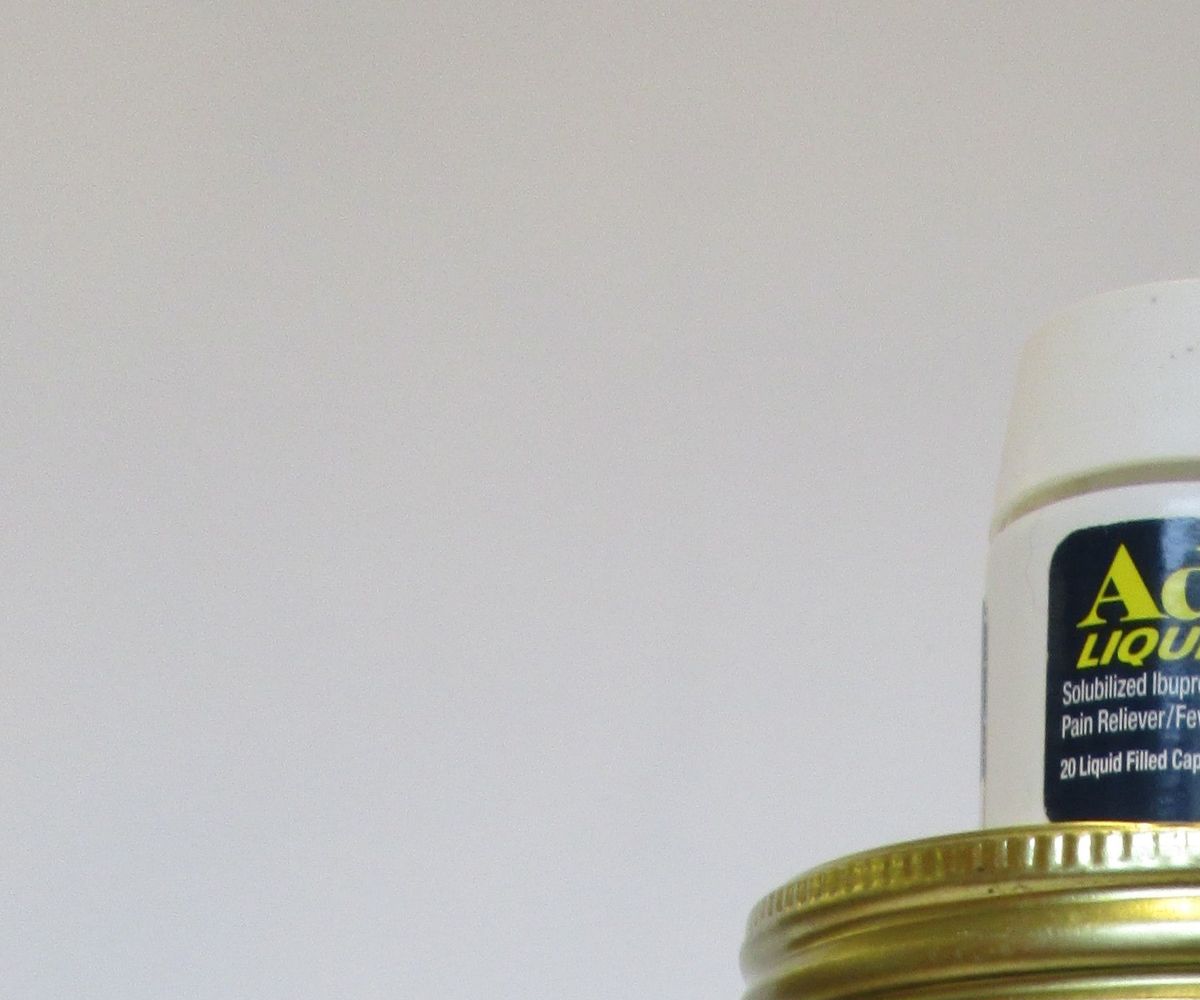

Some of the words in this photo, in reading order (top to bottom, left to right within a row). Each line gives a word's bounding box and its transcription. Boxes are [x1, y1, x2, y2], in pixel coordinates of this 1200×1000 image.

[1062, 671, 1148, 706] Solubilized
[1061, 711, 1093, 739] Pain
[1060, 757, 1077, 780] 20
[1079, 752, 1122, 779] Liquid
[1126, 749, 1168, 773] Filled
